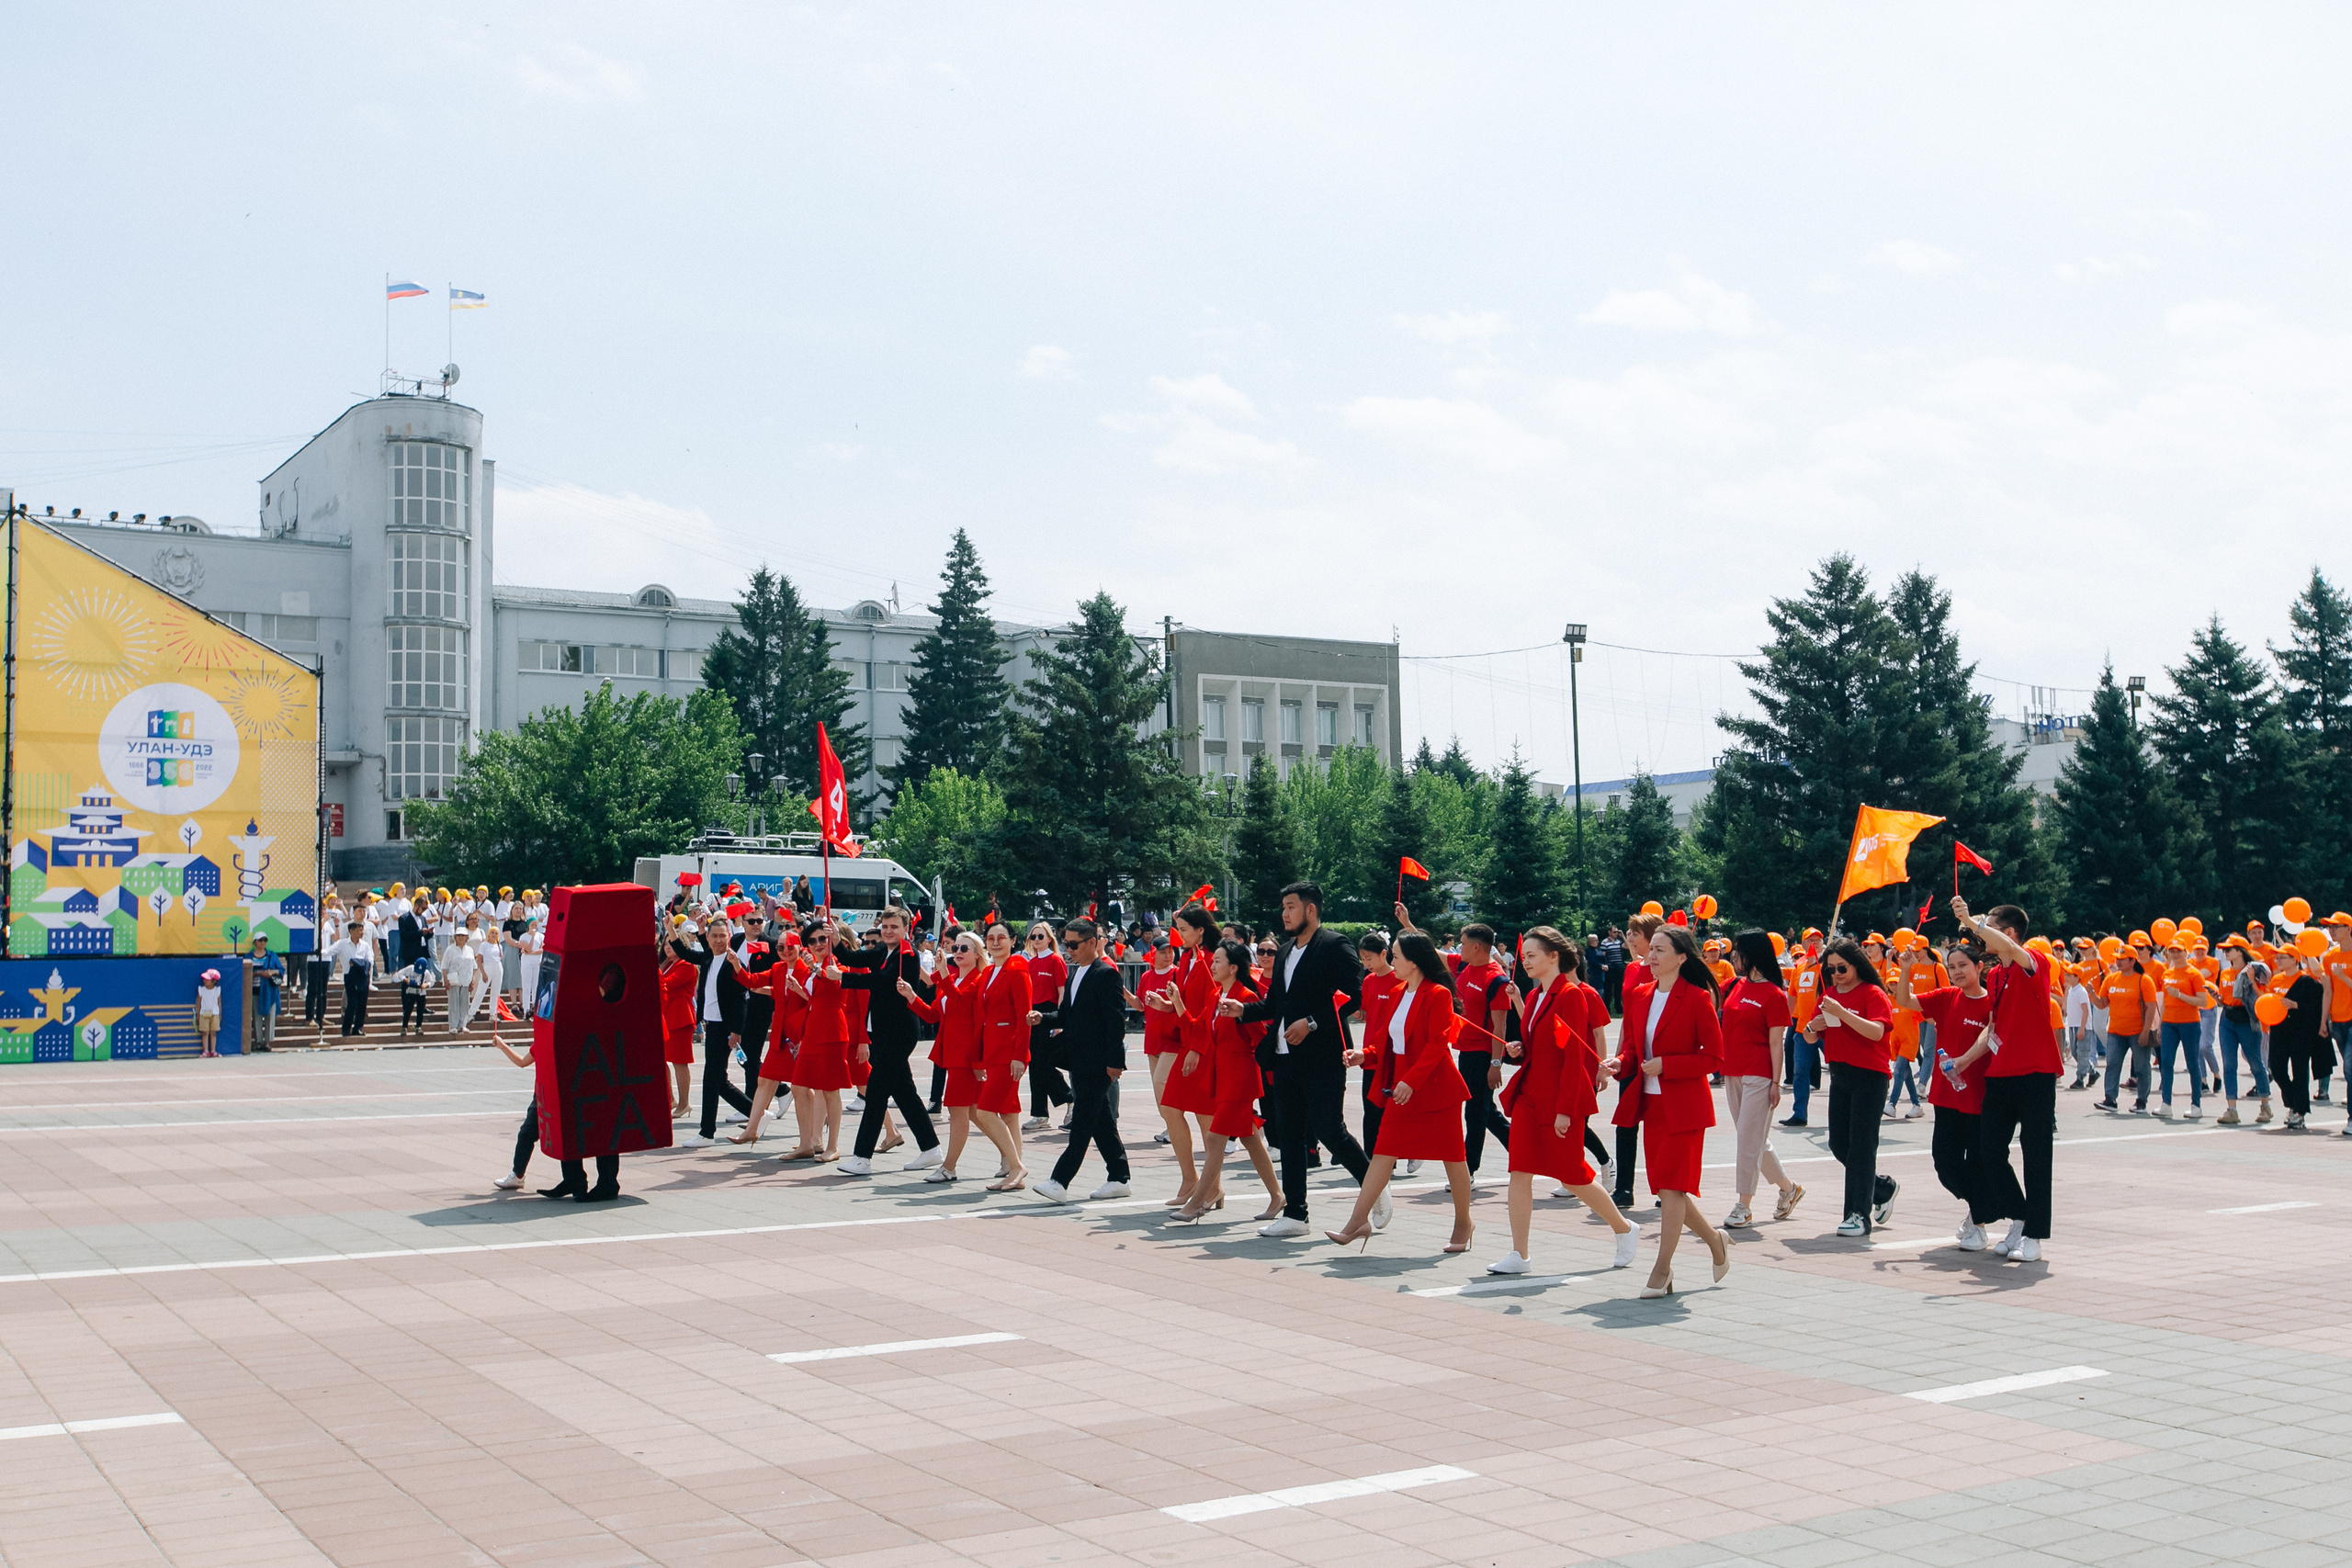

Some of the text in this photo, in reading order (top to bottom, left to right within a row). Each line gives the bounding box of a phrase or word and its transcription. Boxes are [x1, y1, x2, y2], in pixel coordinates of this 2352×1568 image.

[128, 741, 213, 758] УЛАН-УДЭ
[147, 761, 193, 781] 356
[571, 1031, 654, 1092] AL
[573, 1091, 655, 1155] FA
